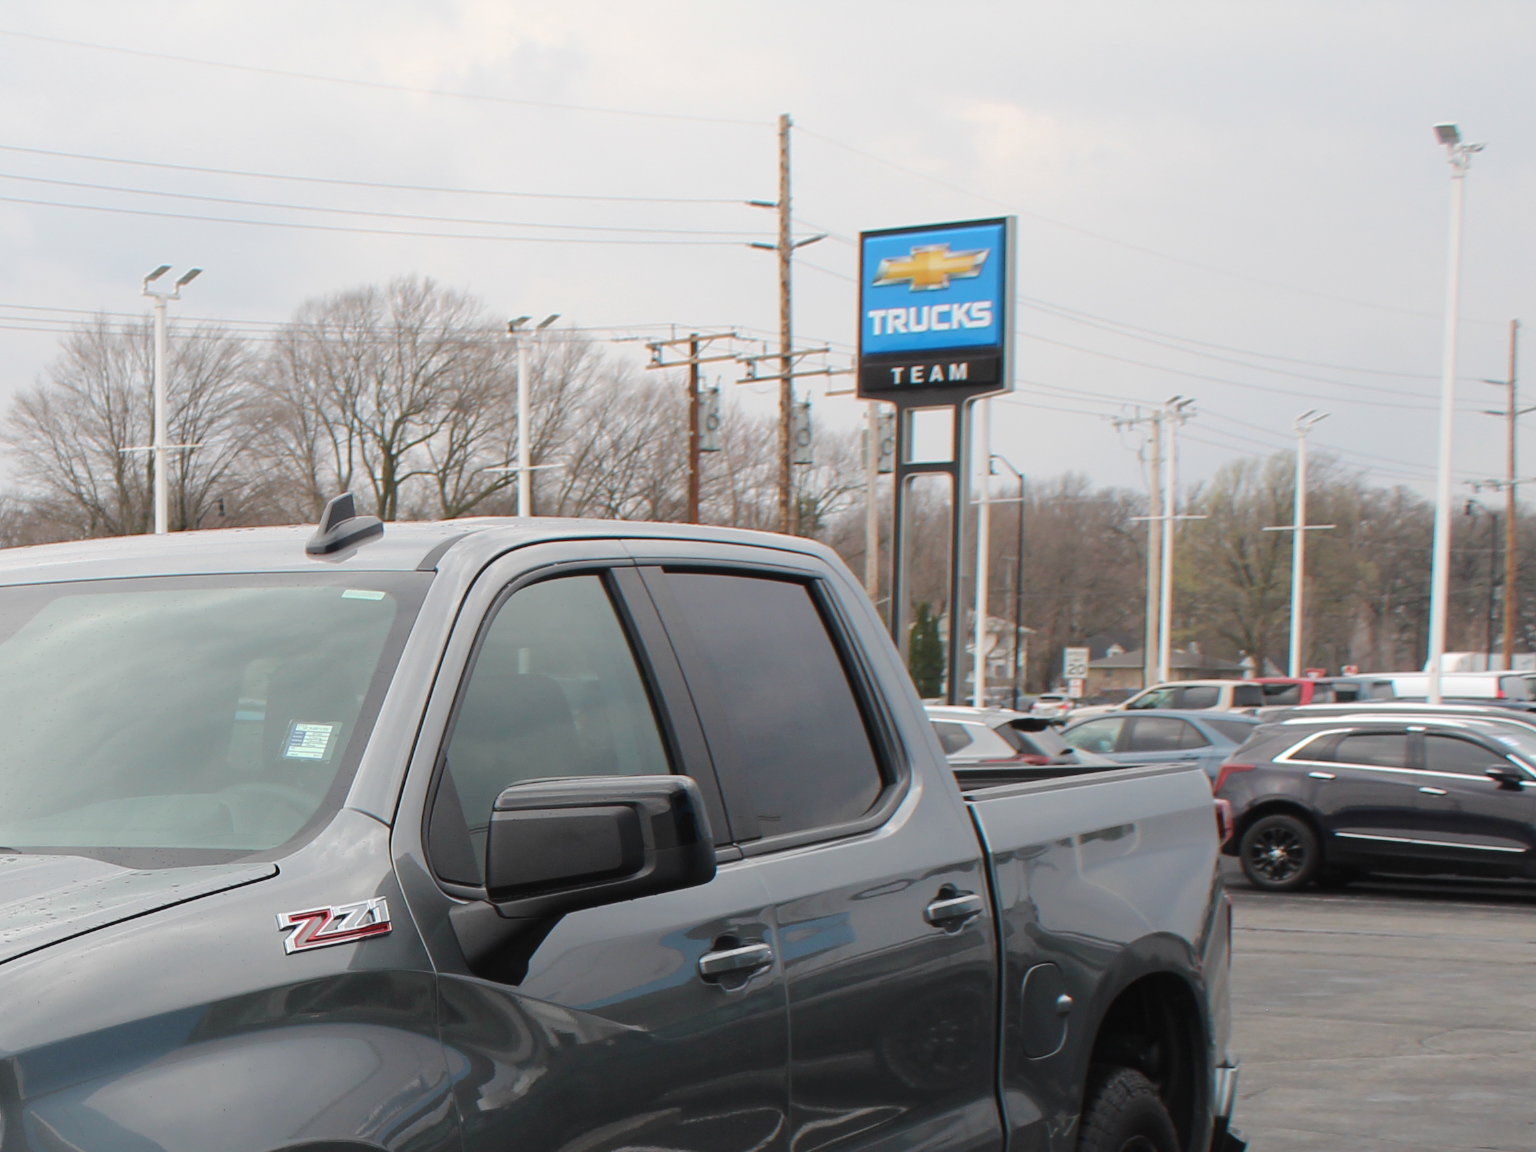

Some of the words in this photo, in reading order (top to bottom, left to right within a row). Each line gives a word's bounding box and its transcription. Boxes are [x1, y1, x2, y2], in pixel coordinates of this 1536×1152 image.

[868, 300, 993, 336] TRUCKS
[891, 362, 968, 385] TEAM
[1067, 663, 1087, 676] 20
[276, 896, 393, 955] Z71
